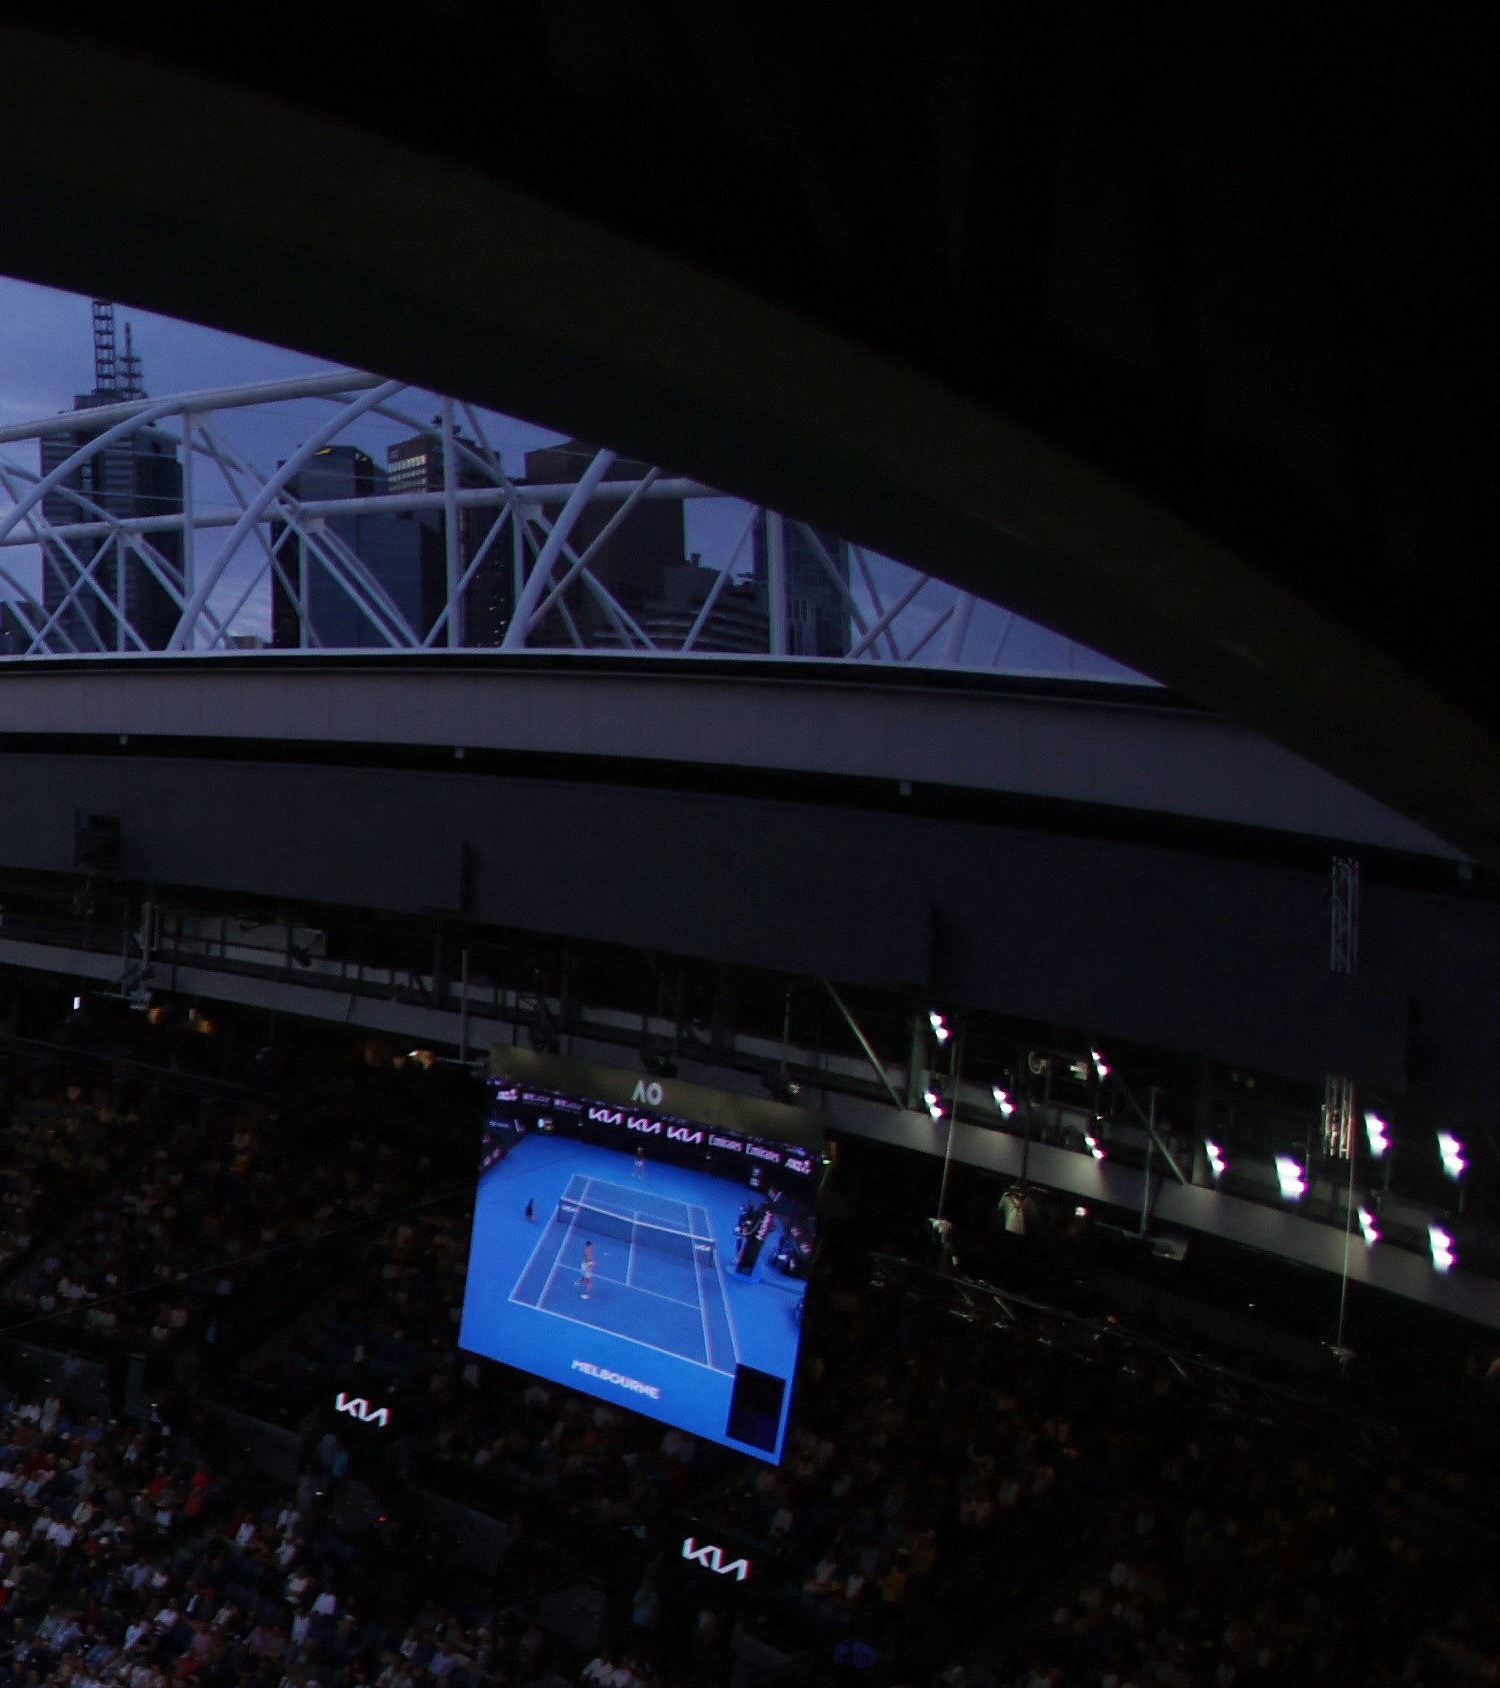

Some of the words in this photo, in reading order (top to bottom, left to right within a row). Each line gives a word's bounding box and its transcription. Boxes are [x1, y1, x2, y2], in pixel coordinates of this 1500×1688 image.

[632, 1080, 663, 1105] AO
[572, 1360, 660, 1399] MELBOURNE
[335, 1392, 391, 1428] KIA
[682, 1537, 749, 1581] KIA
